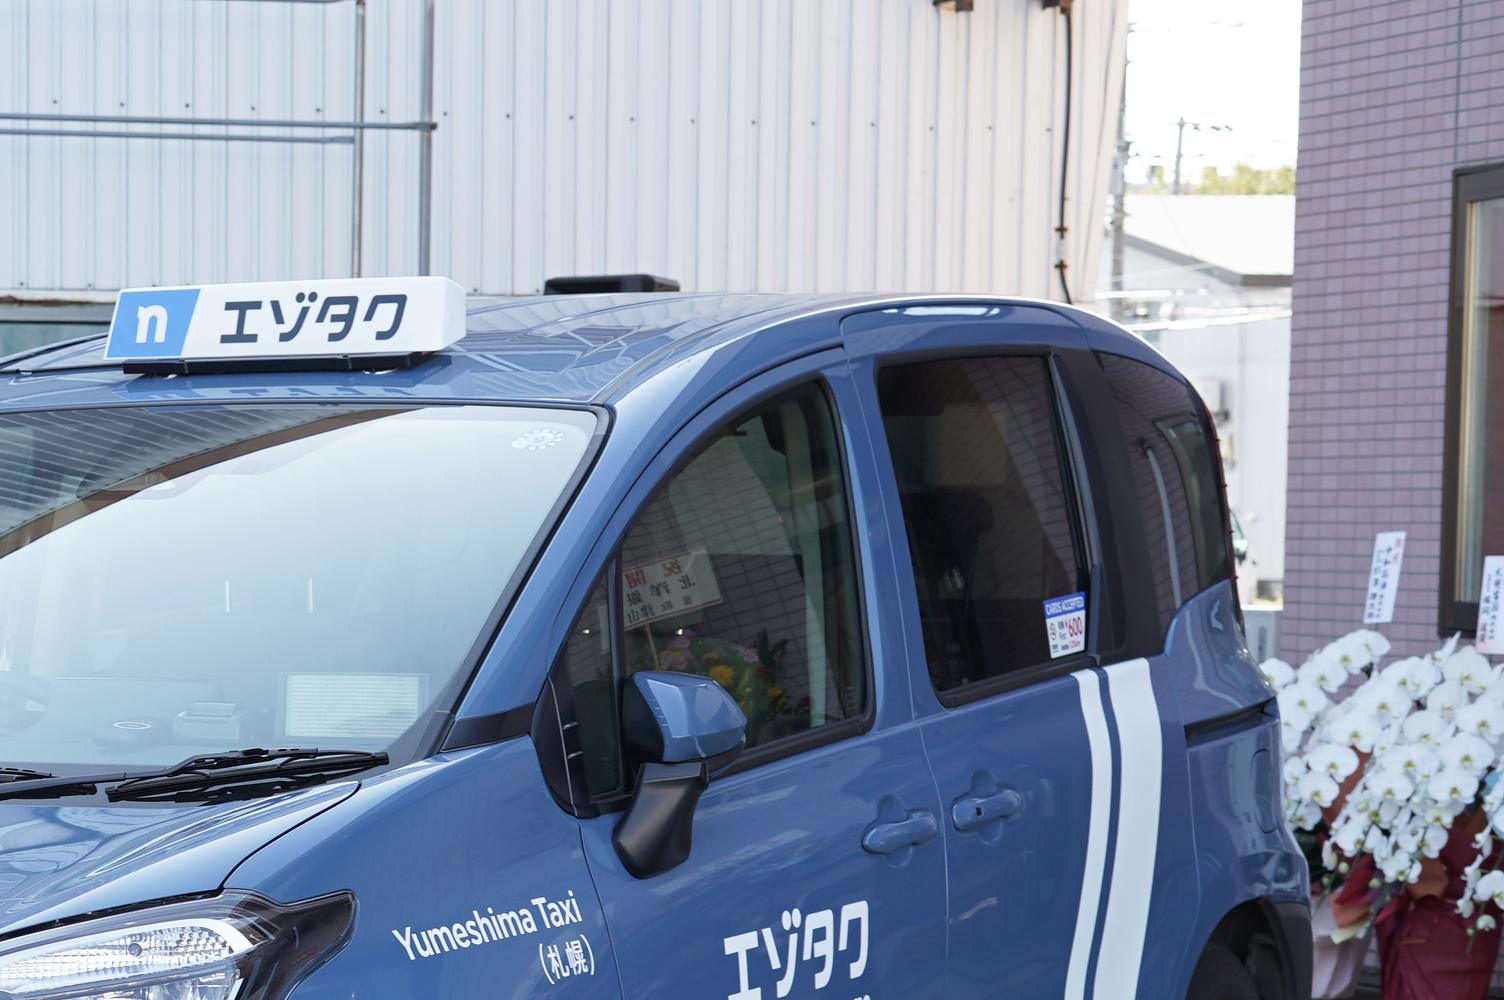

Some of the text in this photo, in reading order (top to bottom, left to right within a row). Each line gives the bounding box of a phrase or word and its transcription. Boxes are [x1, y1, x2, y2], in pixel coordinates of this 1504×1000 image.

[134, 291, 408, 345] n エゾタク
[391, 889, 583, 961] Yumeshima Taxi
[538, 933, 595, 985] (札幌)
